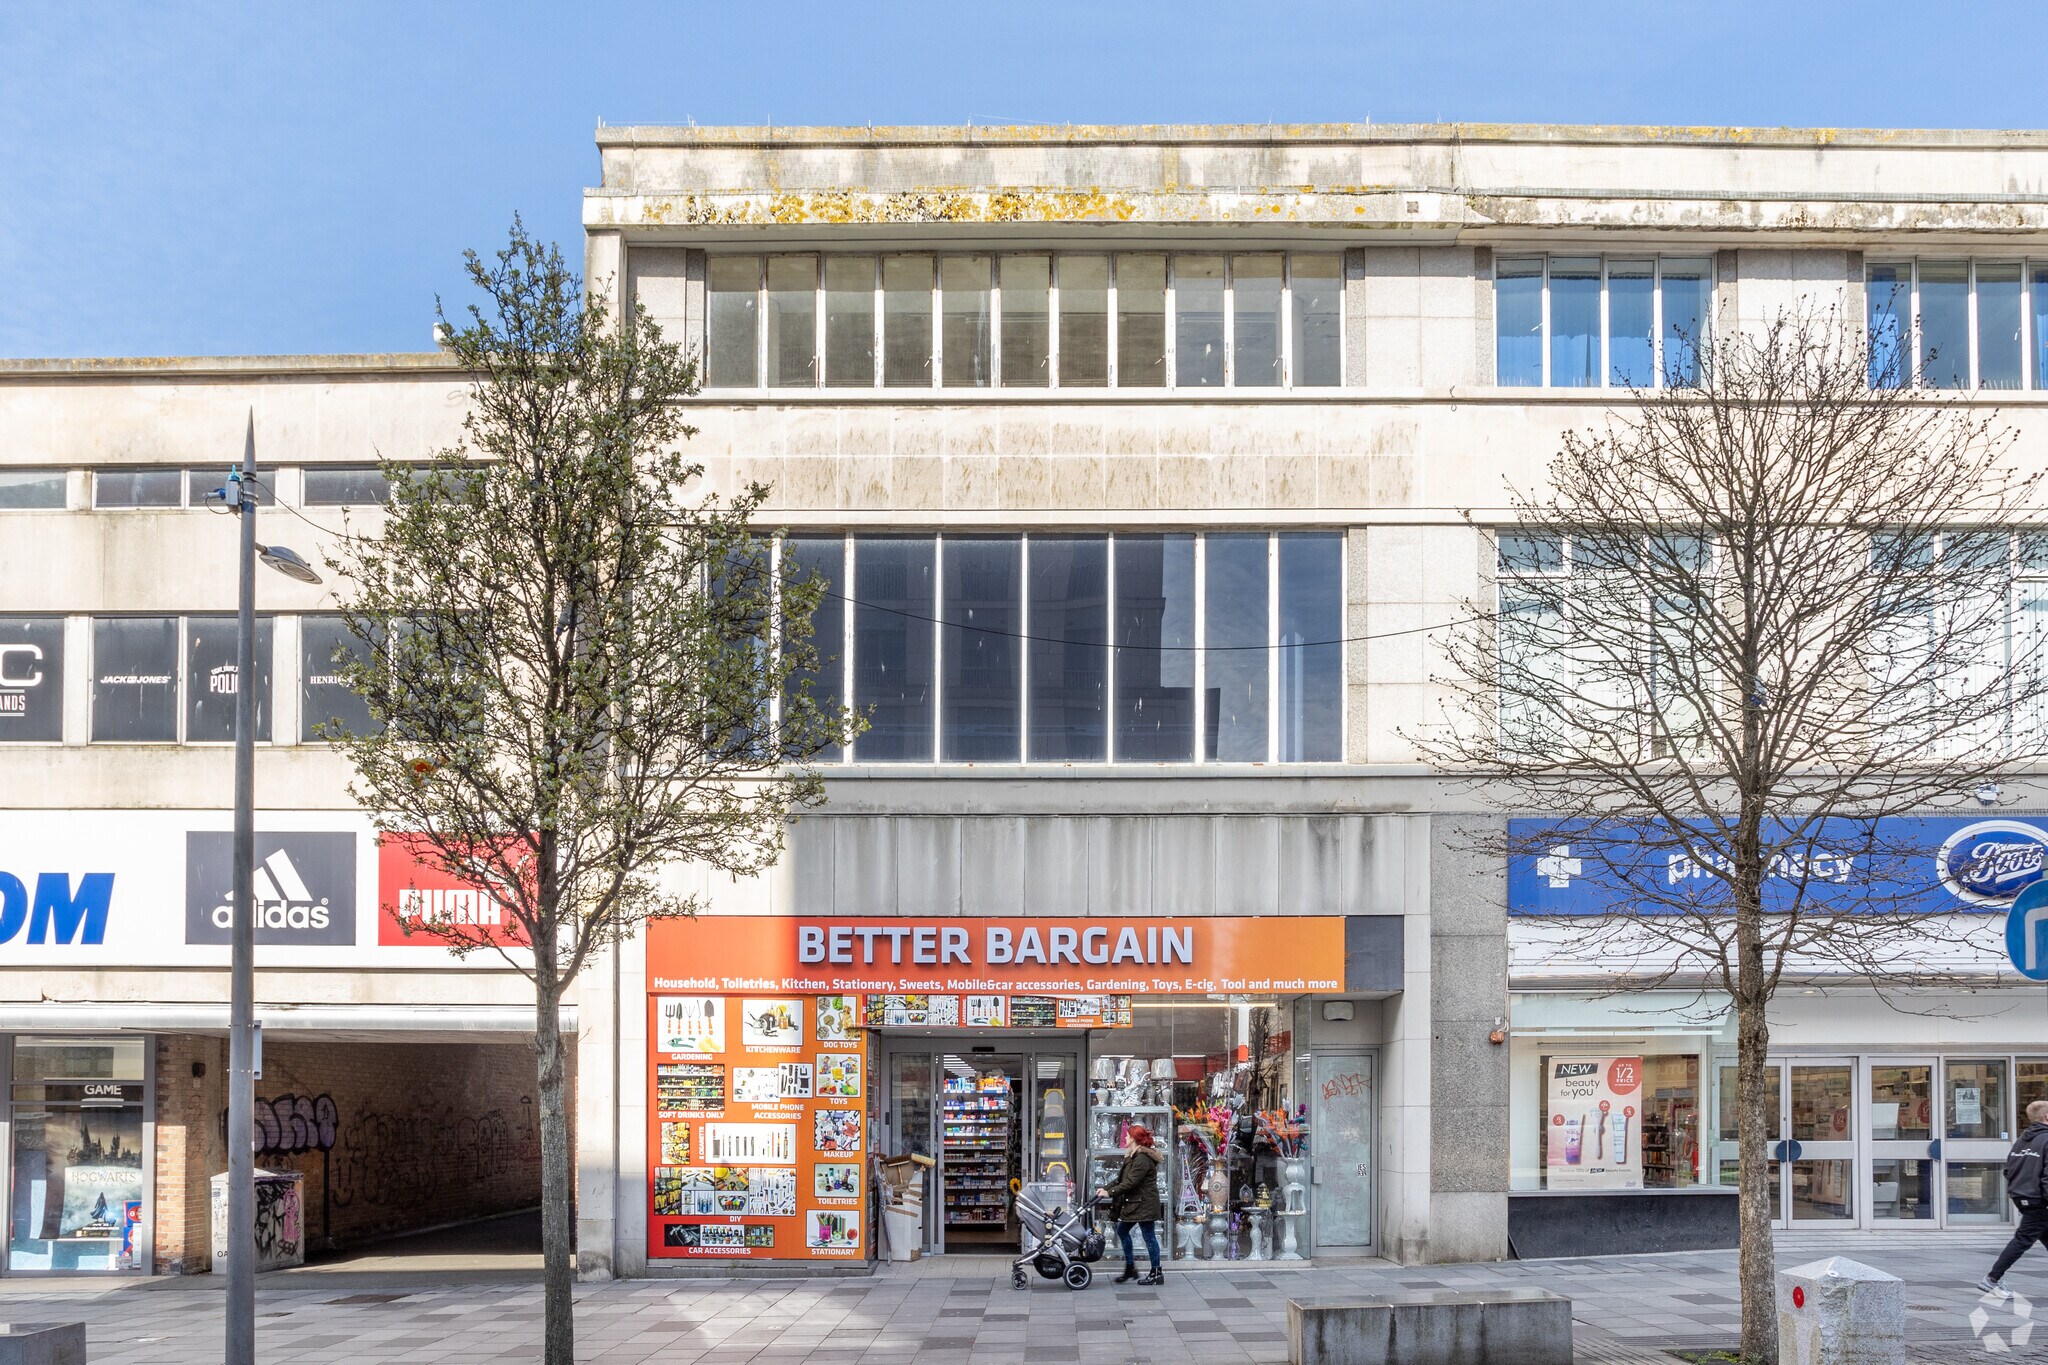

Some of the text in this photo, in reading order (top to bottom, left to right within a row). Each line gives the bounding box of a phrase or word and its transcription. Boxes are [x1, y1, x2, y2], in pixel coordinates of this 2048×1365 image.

[212, 899, 329, 929] aidas
[799, 926, 1193, 964] BETTER BARGAIN
[654, 977, 1338, 991] Household, Toiletries, Kitchen, Stationery, Sweets, Mobile&car accessories, Gardening, Toys, E-cig, Tool and much more
[824, 1041, 857, 1049] DOG TOYS
[746, 1046, 801, 1054] KITCHENWARE
[672, 1053, 713, 1061] GARDENING
[1561, 1064, 1592, 1075] NEW
[1616, 1067, 1633, 1078] 1/2
[1566, 1078, 1600, 1089] beauty
[84, 1084, 122, 1095] GAME
[1572, 1089, 1594, 1099] you
[751, 1103, 804, 1111] MOBILE PHONE
[658, 1111, 725, 1119] SOFT DRINKS ONLY
[754, 1112, 802, 1120] ACCESSORIES
[72, 1170, 137, 1184] HOGWARTS
[729, 1215, 741, 1223] DIY
[704, 1247, 751, 1255] ACCESSORIES
[811, 1248, 855, 1256] STATIONARY
